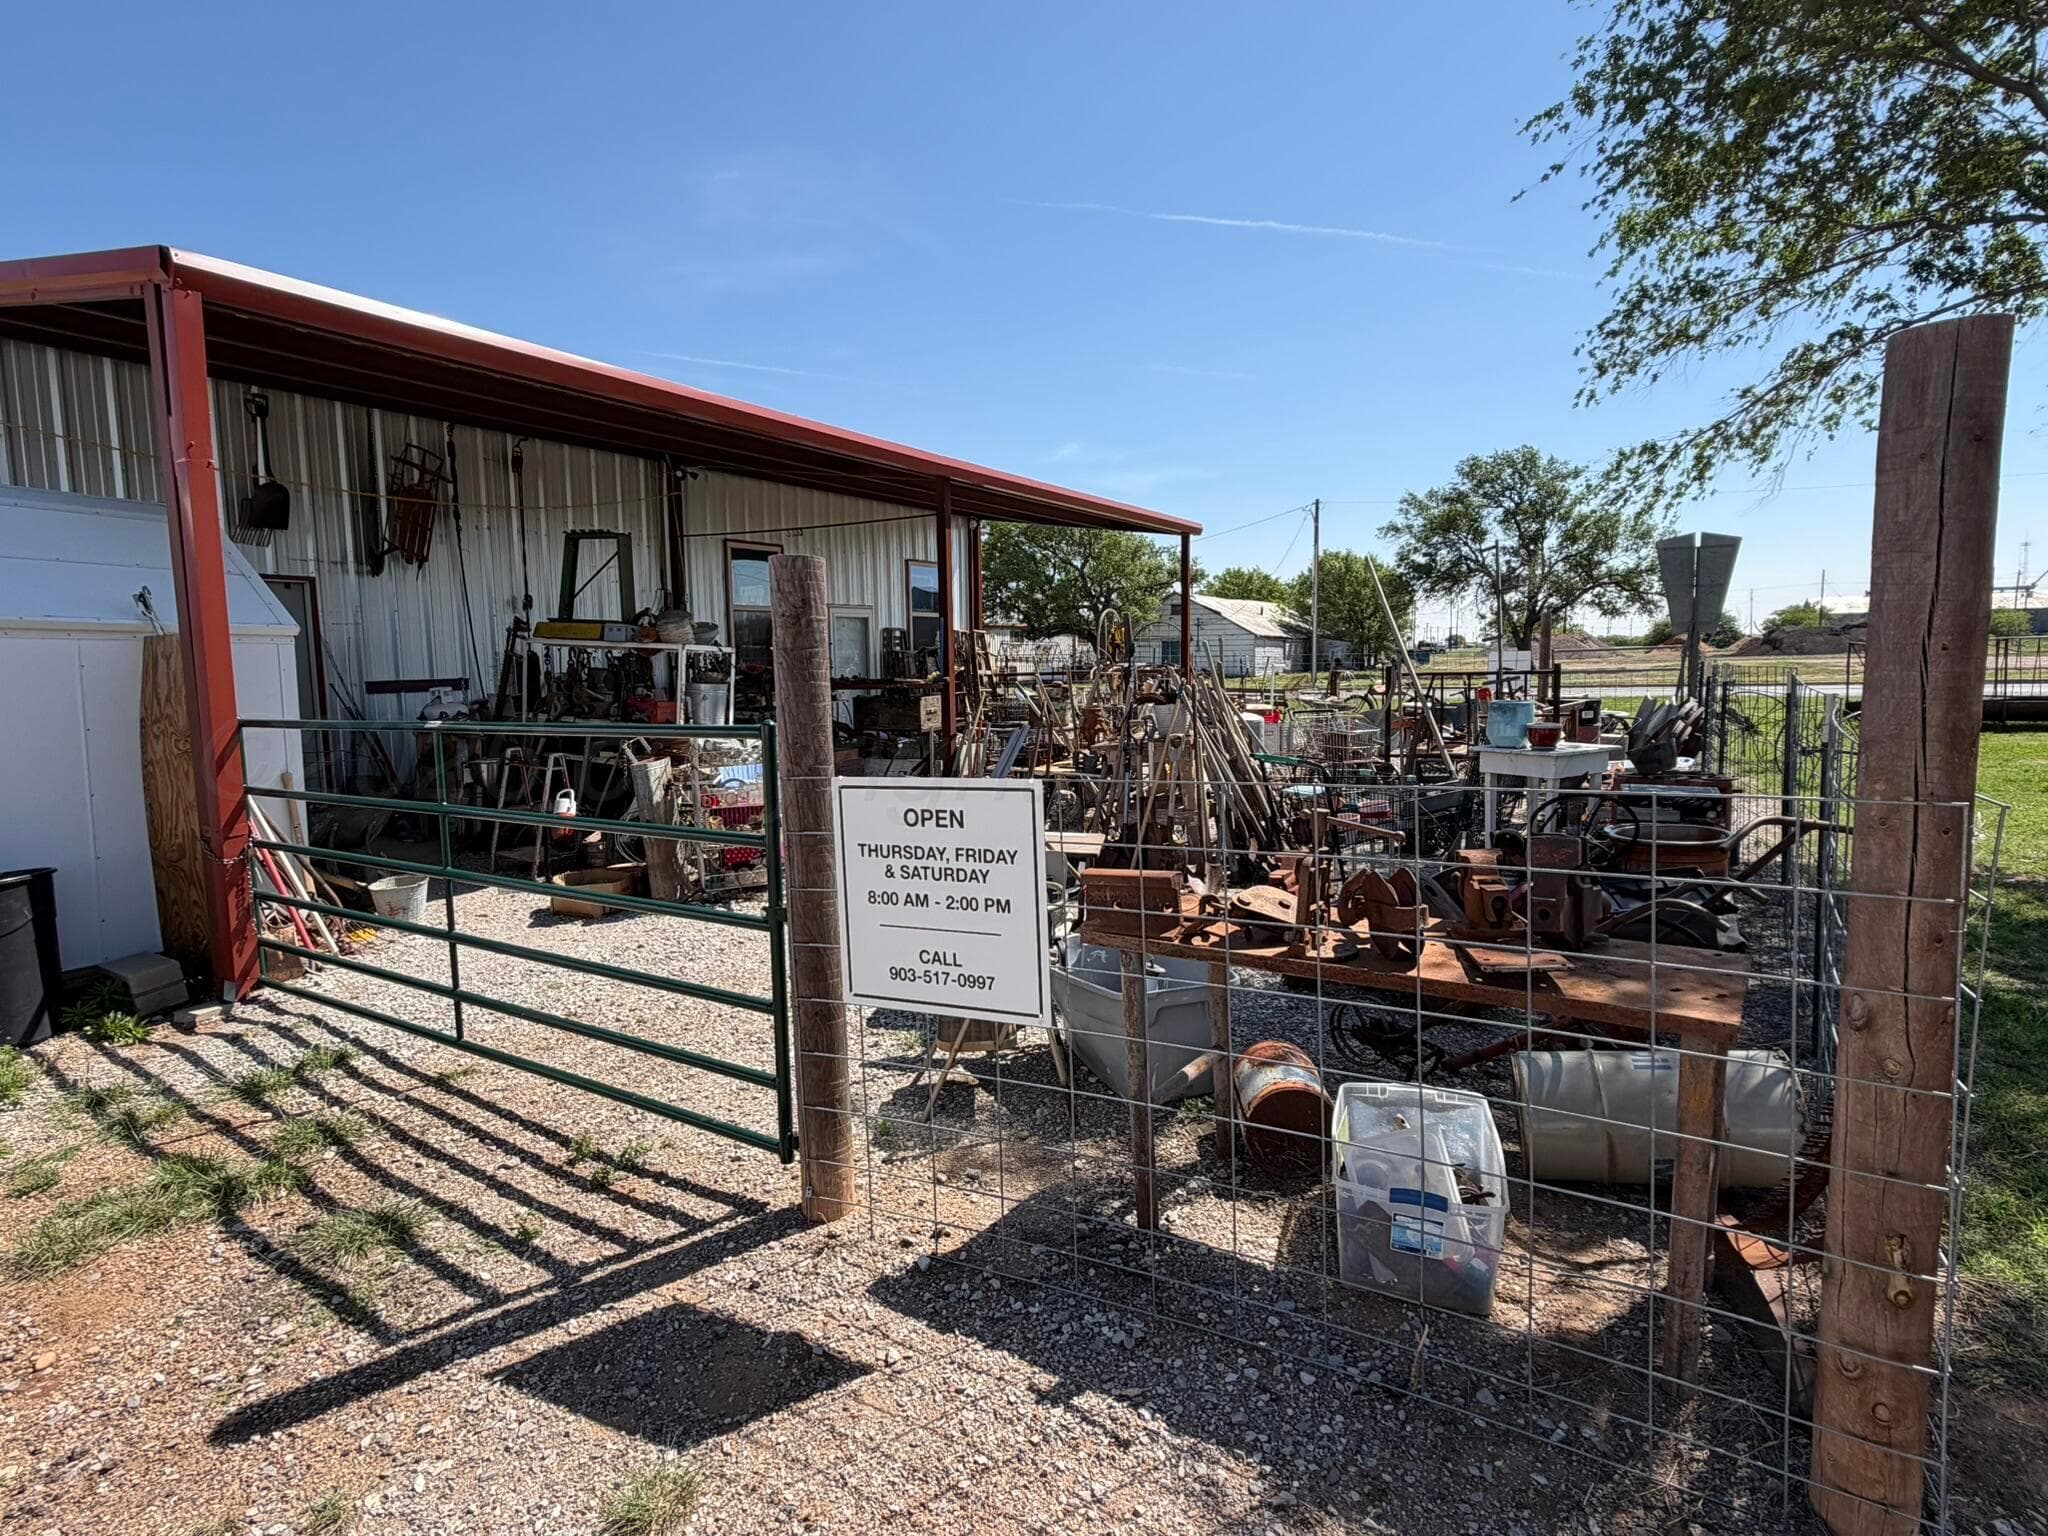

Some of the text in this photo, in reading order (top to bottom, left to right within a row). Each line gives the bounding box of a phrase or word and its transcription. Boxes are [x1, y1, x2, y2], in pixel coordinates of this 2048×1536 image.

[903, 808, 964, 829] OPEN
[857, 843, 1018, 865] THURSDAY, FRIDAY
[885, 864, 990, 884] & SATURDAY
[868, 890, 899, 906] 8:00
[903, 892, 929, 908] AM
[946, 895, 979, 912] 2:00
[984, 898, 1011, 914] PM
[919, 949, 963, 968] CALL
[889, 966, 995, 991] 903-517-0997
